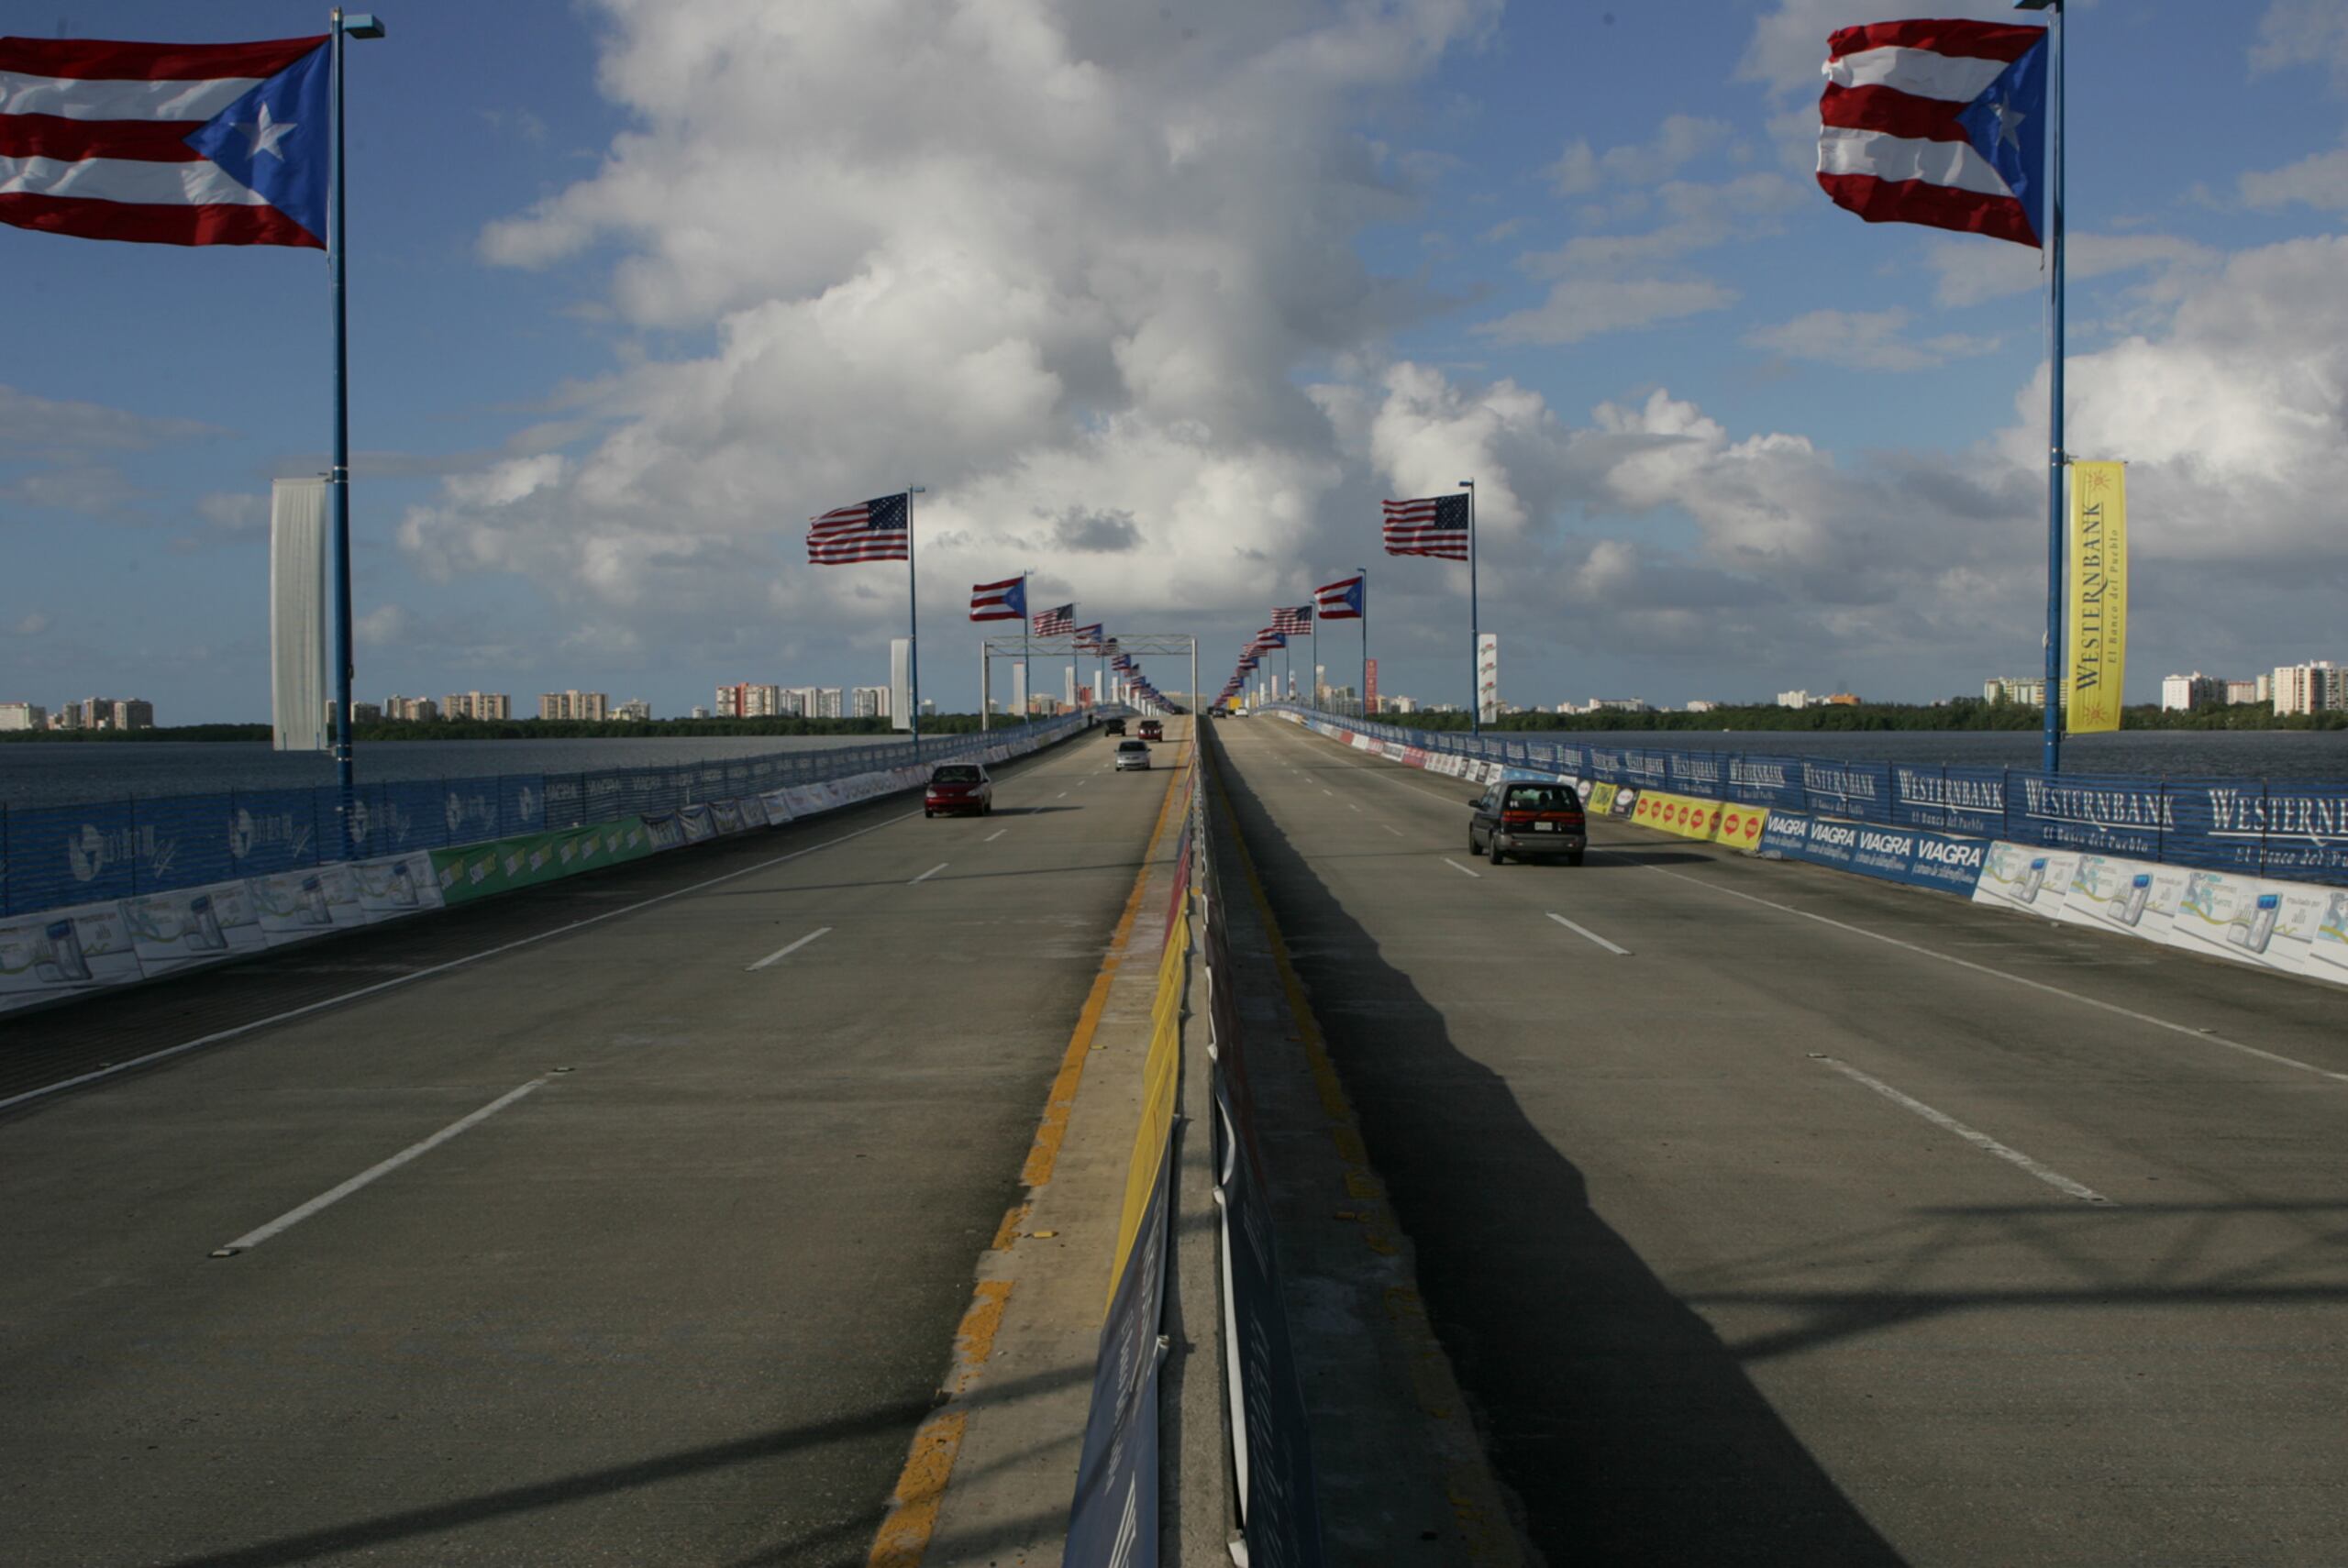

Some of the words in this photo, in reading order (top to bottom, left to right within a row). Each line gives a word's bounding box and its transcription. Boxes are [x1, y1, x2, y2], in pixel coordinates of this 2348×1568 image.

[2110, 529, 2119, 573] Pueblo
[2076, 502, 2108, 692] WESTERNBANK
[2109, 580, 2119, 600] del
[2109, 606, 2118, 645] Banco
[1898, 768, 2004, 813] WESTERNBANK
[2025, 778, 2175, 832] WESTERNBANK
[1767, 814, 1807, 837] VIAGRA
[1810, 822, 1855, 848] VIAGRA
[1859, 831, 1911, 856] VIAGRA
[1917, 838, 1981, 868] VIAGRA
